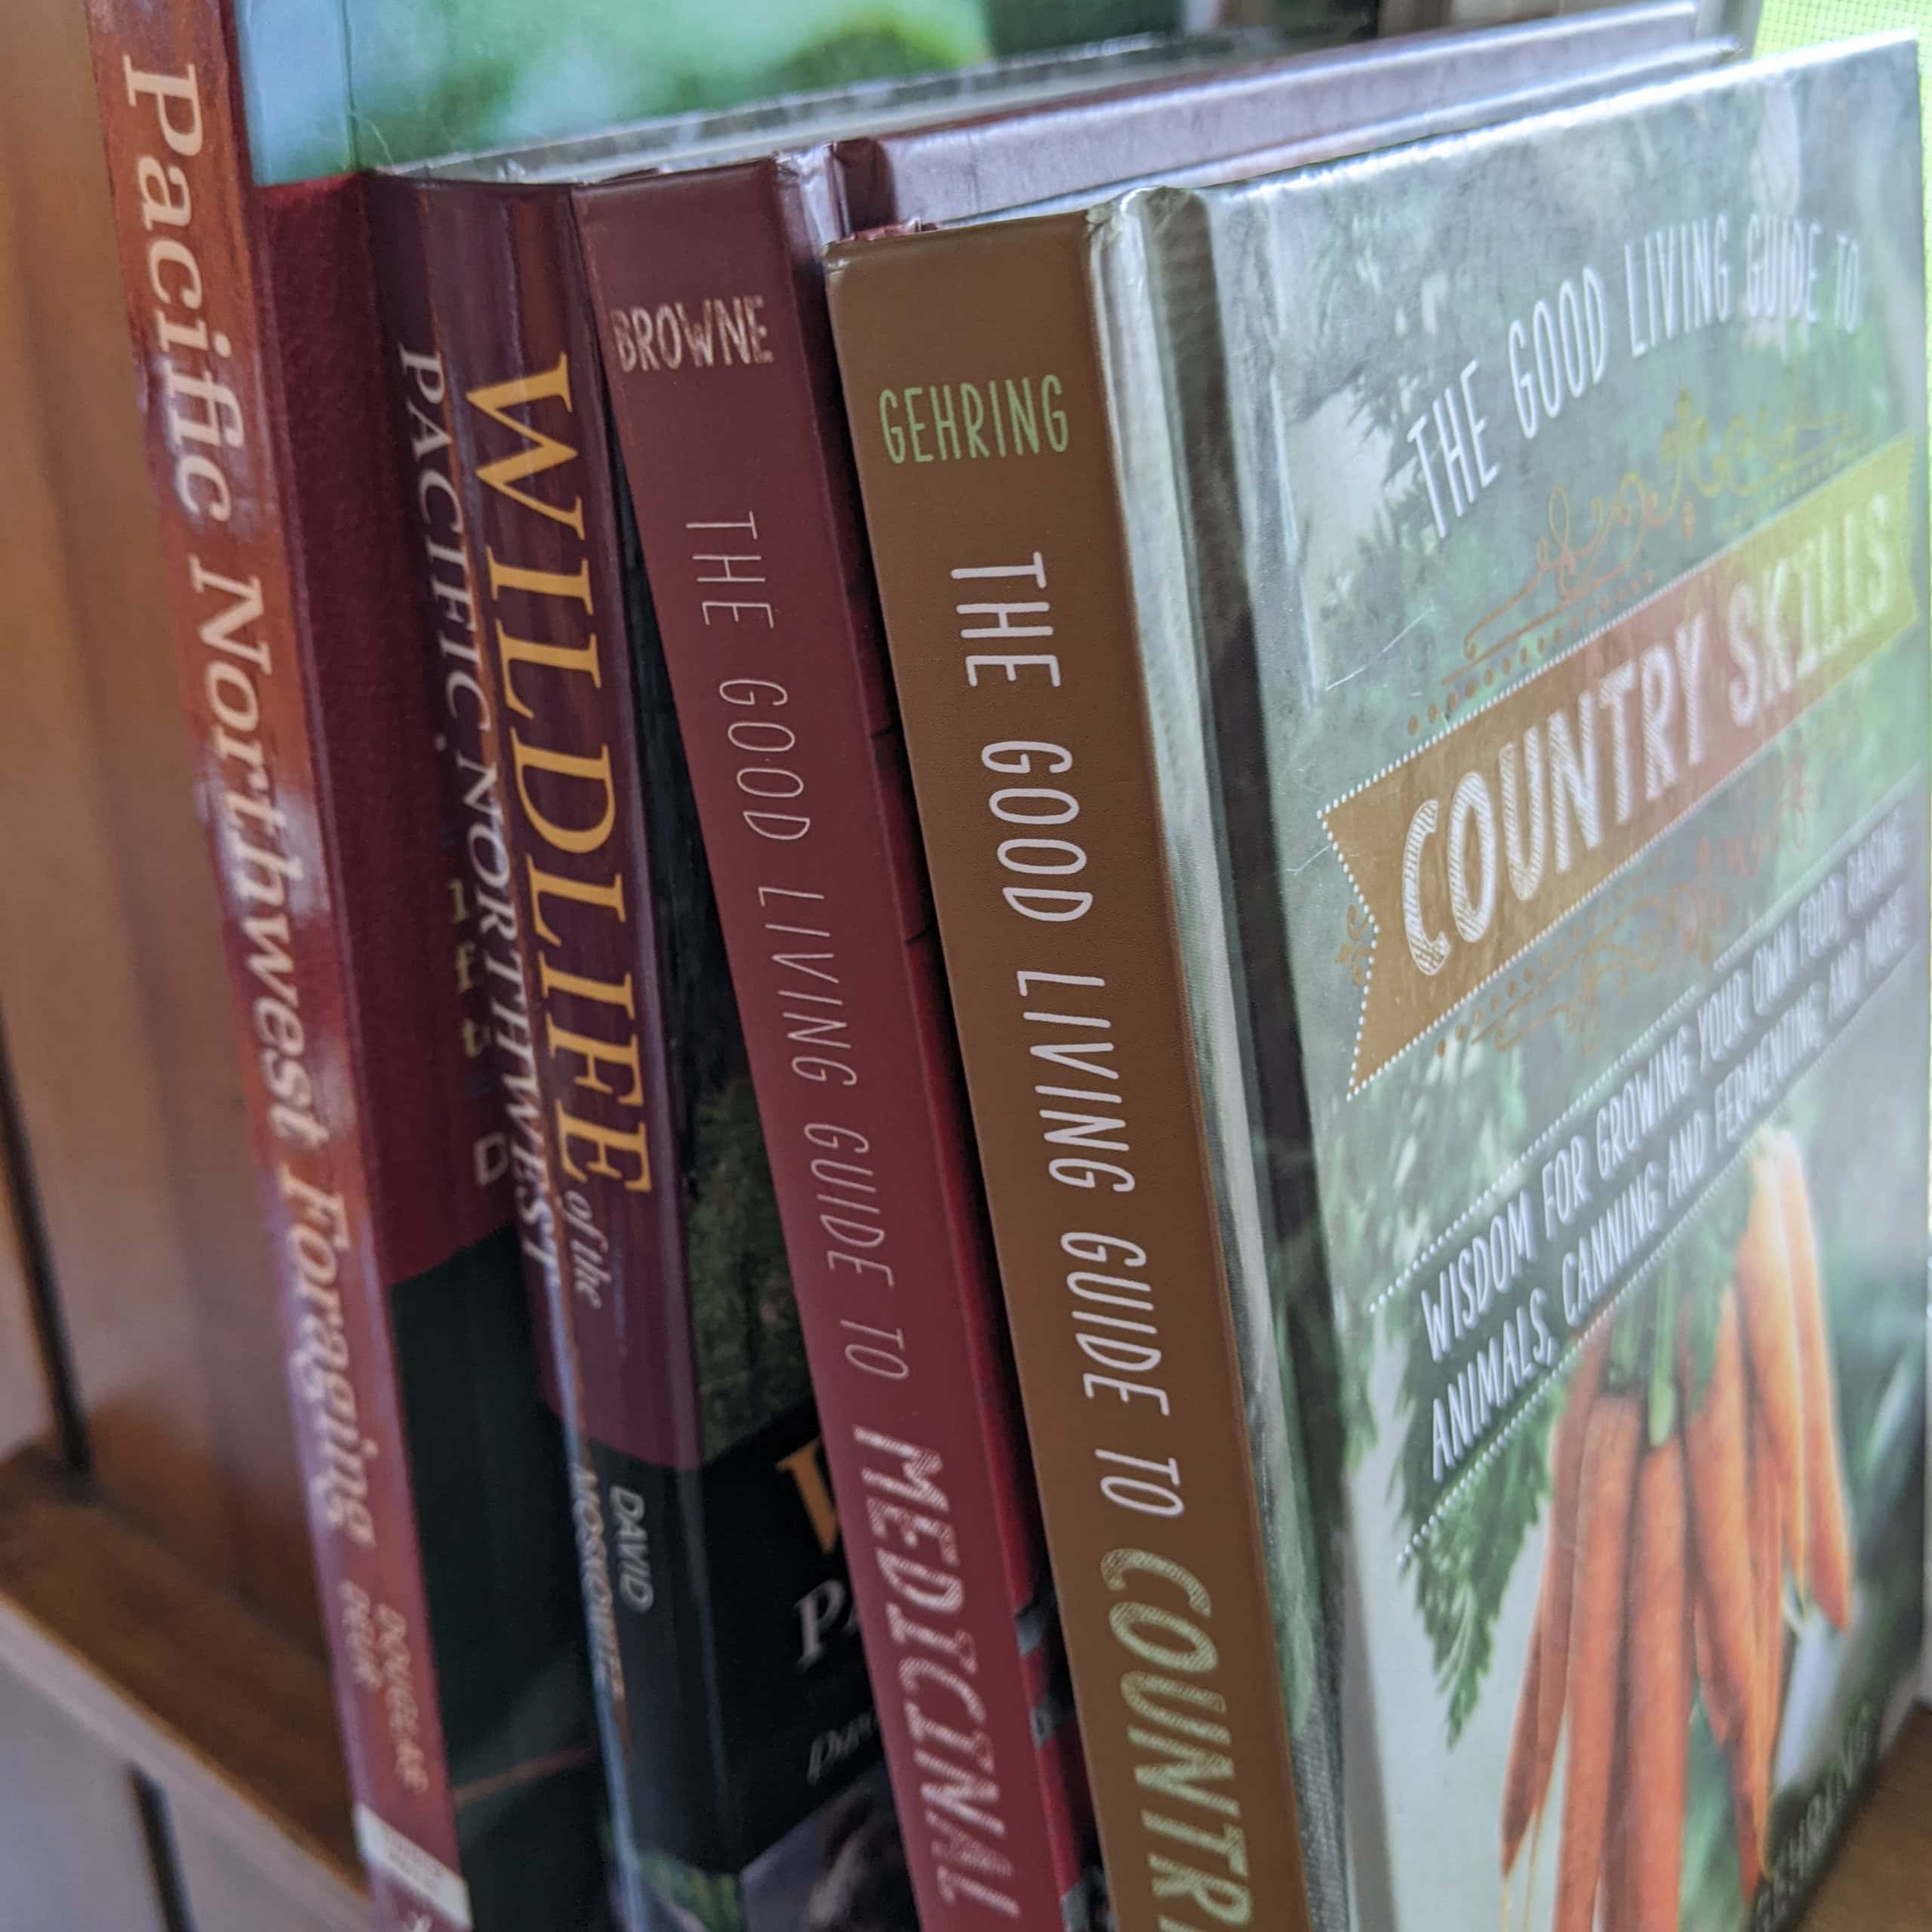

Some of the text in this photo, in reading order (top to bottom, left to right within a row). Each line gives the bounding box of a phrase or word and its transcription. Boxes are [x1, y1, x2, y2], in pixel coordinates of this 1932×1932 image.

[612, 296, 773, 372] BROWNE
[880, 375, 1069, 463] GEHRING
[1407, 214, 1861, 537] THE GOOD LIVING GUIDE TO
[123, 55, 378, 1547] Pacific Northwest Foraging
[399, 343, 491, 733] PACIFIC
[456, 750, 561, 1285] NORTHWEST
[466, 352, 651, 1192] WILDLIFE
[1402, 494, 1888, 975] COUNTRY SKILLS
[555, 1190, 609, 1253] of
[570, 1239, 612, 1309] the
[686, 511, 1020, 1918] THE GOOD LIVING GUIDE TO MEDICINAL
[951, 552, 1256, 1932] THE GOOD LIVING GUIDE TO COUNTR
[1421, 1189, 1537, 1363] WISDOM
[1543, 1135, 1592, 1240] FOR
[1597, 1024, 1691, 1181] GROWING
[1697, 969, 1752, 1074] YOUR
[1752, 918, 1798, 1016] OWN
[1434, 1287, 1559, 1479] ANIMALS,
[1562, 1161, 1662, 1327] CANNING
[1668, 1110, 1712, 1208] AND
[610, 1485, 654, 1613] DAVID
